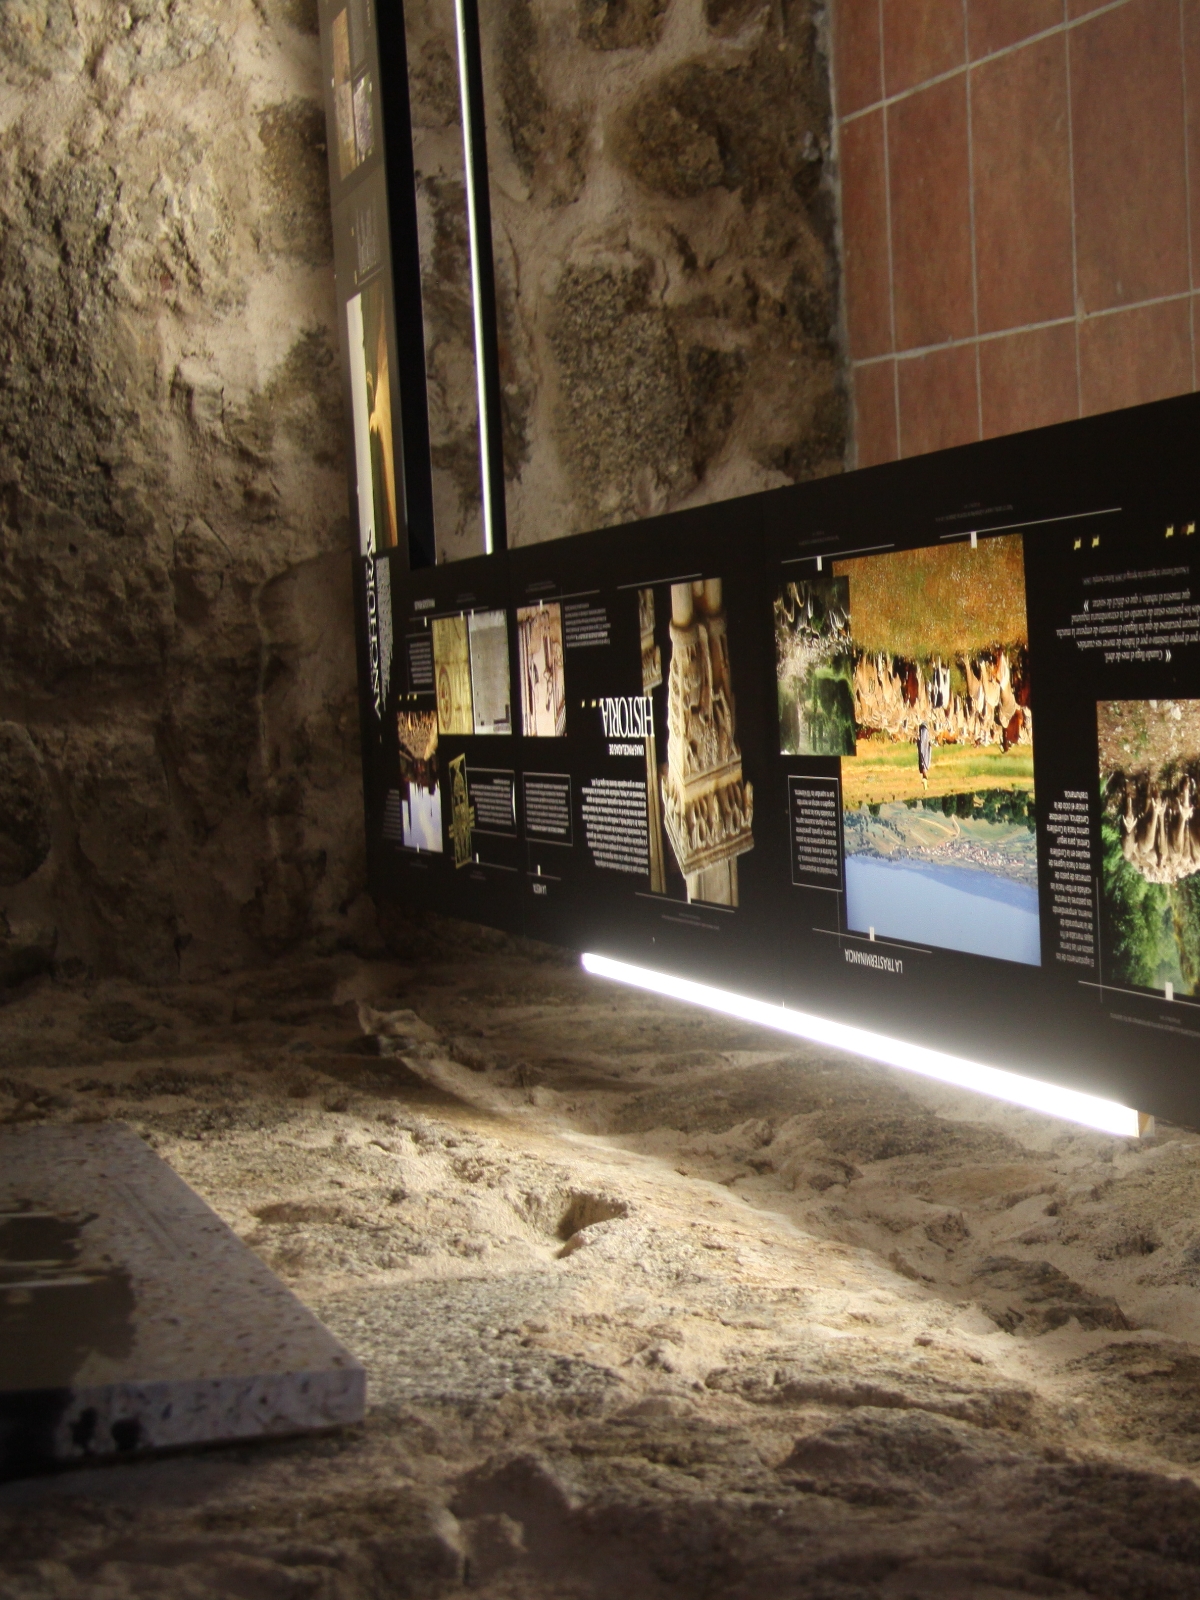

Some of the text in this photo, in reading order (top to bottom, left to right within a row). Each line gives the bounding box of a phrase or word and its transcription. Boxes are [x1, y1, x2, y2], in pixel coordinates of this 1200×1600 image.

[600, 696, 655, 738] HISTORIA
[844, 948, 903, 974] LA TRASTERMINANCIA
